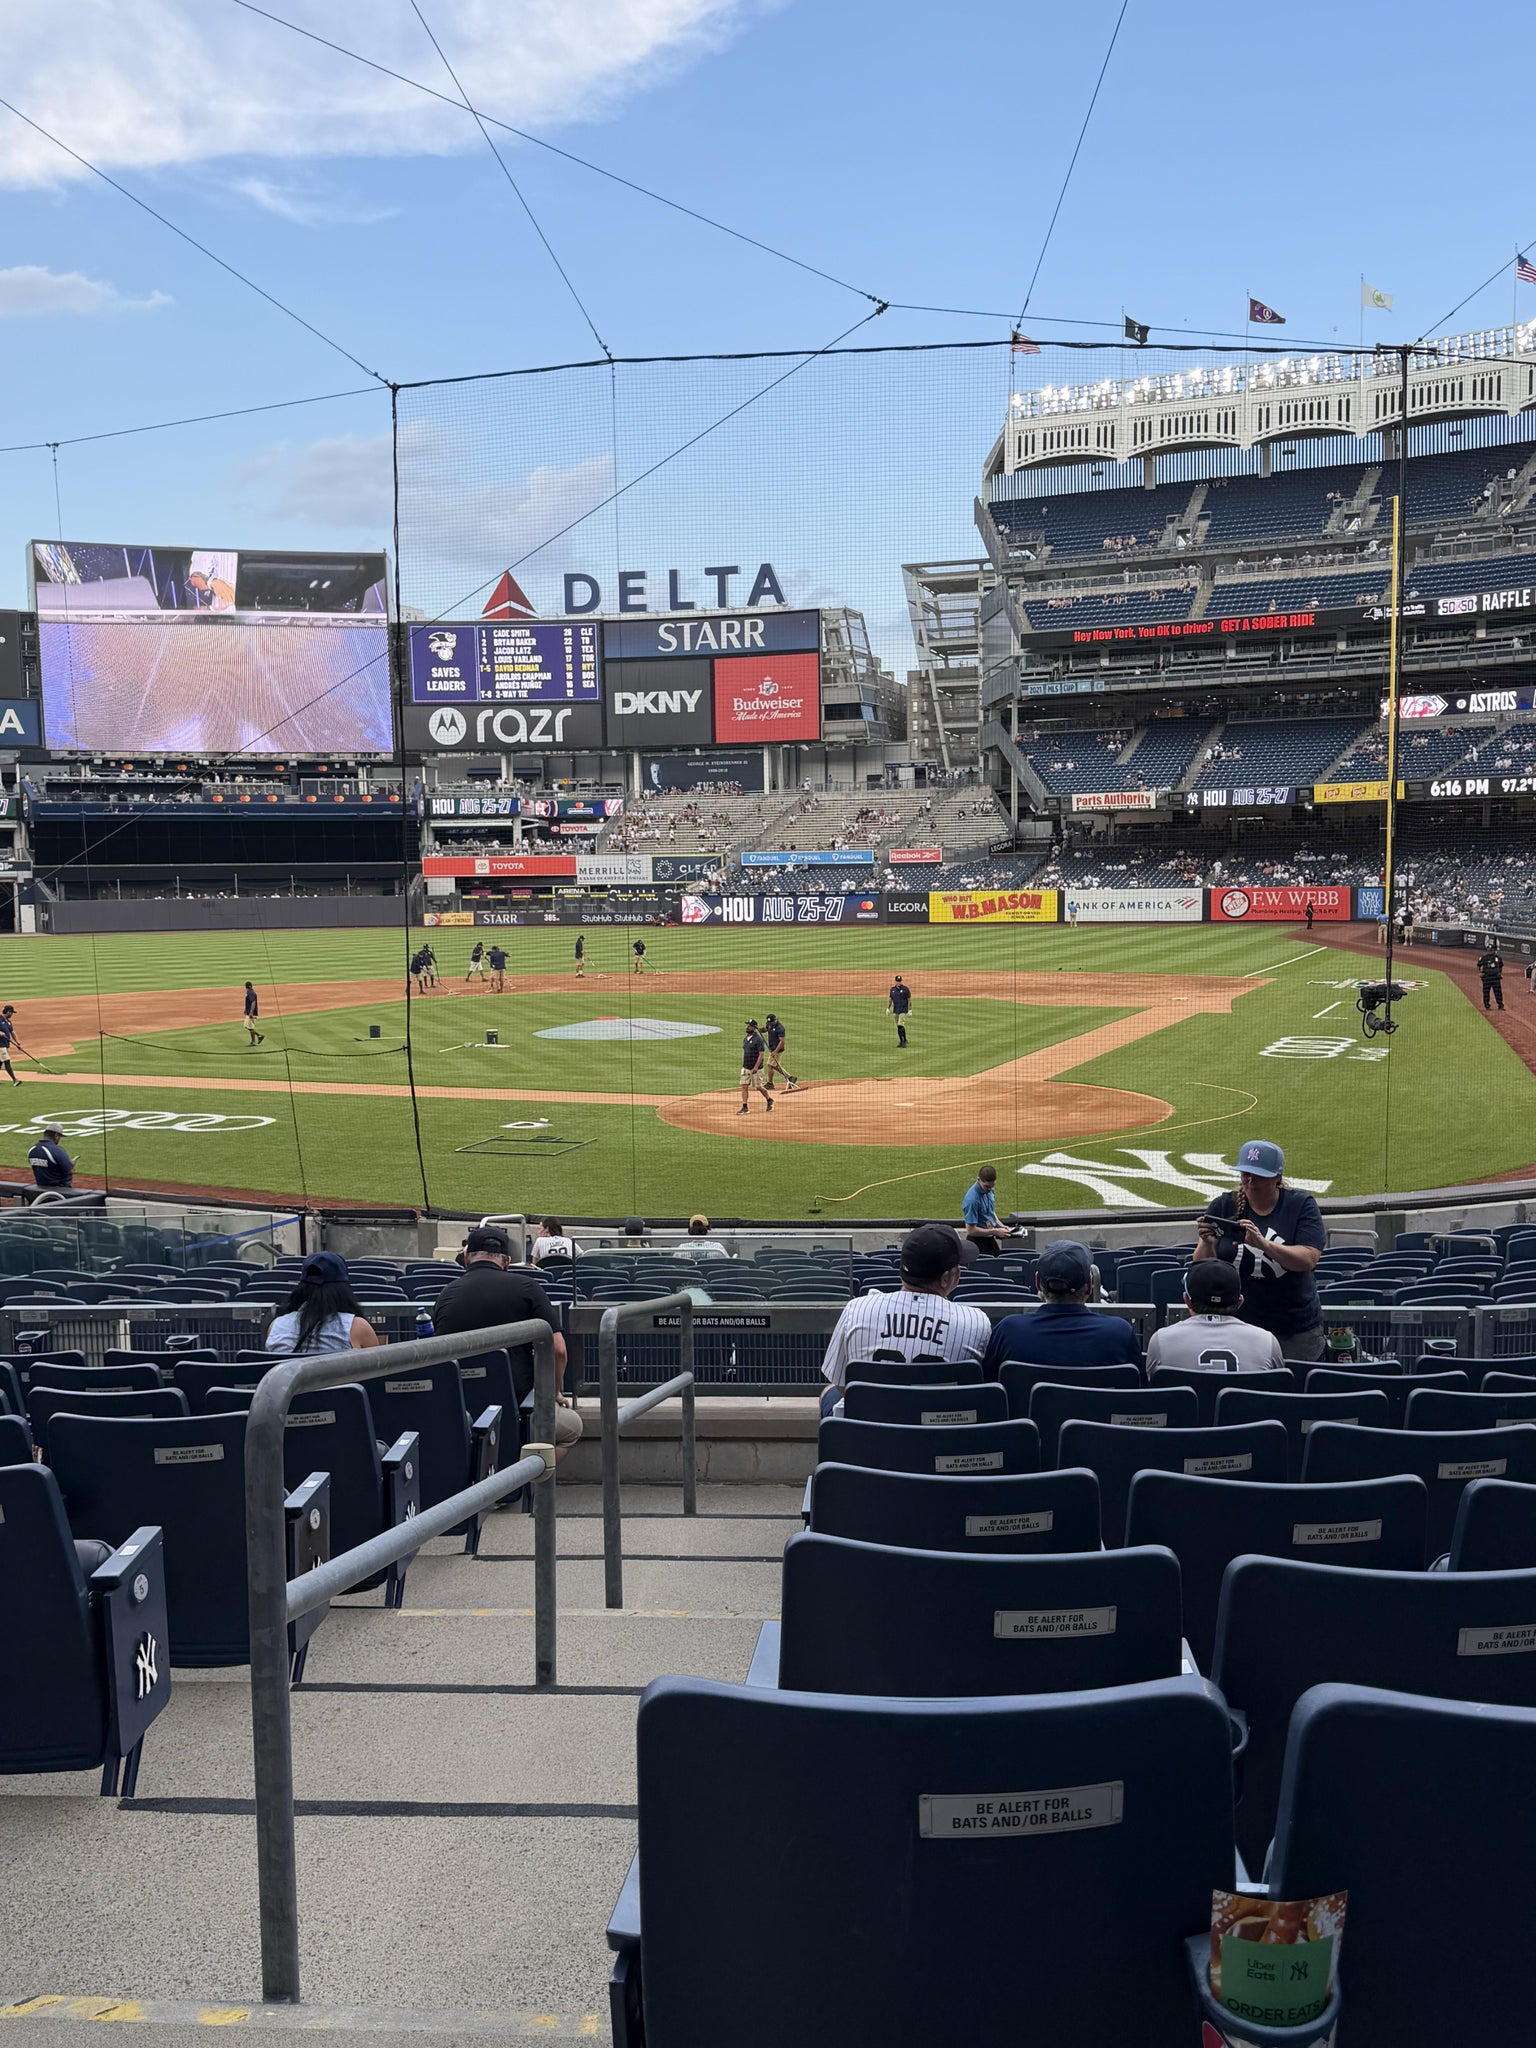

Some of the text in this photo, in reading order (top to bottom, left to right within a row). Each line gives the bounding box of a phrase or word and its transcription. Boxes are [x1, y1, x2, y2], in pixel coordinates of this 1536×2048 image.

[564, 563, 788, 614] DELTA
[1482, 589, 1531, 611] RAFFLE
[1221, 613, 1315, 633] GET A SOBER RIDE
[511, 629, 530, 638] SMITH
[580, 628, 593, 636] CLE
[658, 618, 767, 653] STARR
[1074, 621, 1214, 643] Hey New York, You OK to drive?
[493, 638, 515, 646] BRYAN
[516, 638, 537, 646] BAKER
[563, 637, 573, 645] 22
[494, 647, 515, 655] JACOB
[516, 647, 532, 655] LATZ
[581, 645, 594, 653] TEX
[494, 656, 512, 664] LOUIS
[513, 655, 543, 663] VARLAND
[565, 654, 573, 662] 17
[582, 654, 595, 662] TOR
[431, 667, 460, 678] SAVES
[494, 664, 514, 672] DAVID
[514, 664, 540, 672] BEDNAR
[582, 663, 595, 671] NYY
[523, 672, 551, 680] CHAPMAN
[582, 672, 595, 680] BOS
[426, 681, 466, 691] LEADERS
[582, 680, 595, 688] SEA
[1029, 686, 1043, 694] 2021
[1047, 685, 1059, 693] MLS
[1063, 684, 1075, 692] CUP
[495, 690, 516, 698] 2-WAY
[517, 690, 528, 698] TIE
[614, 690, 702, 715] DKNY
[733, 696, 803, 711] Budweiser
[1469, 690, 1517, 713] ASTROS
[732, 710, 801, 721] Made of America
[476, 708, 572, 743] razr
[1431, 779, 1489, 796] 6:16 PM
[1076, 793, 1151, 806] Parts Authority
[1204, 788, 1289, 806] HOU AUG 25-27
[432, 798, 511, 814] HOU AUG 25-27
[561, 825, 588, 833] TOYOTA
[891, 852, 921, 860] Reebok
[492, 862, 525, 870] TOYOTA
[579, 867, 625, 875] MERRILL
[942, 894, 973, 904] WHO BUT
[1252, 890, 1339, 906] F.W. WEBB
[1362, 892, 1378, 900] NEW
[1394, 890, 1406, 898] 314
[722, 896, 845, 922] HOU AUG 25-27
[888, 902, 928, 913] LEGORA
[1119, 901, 1172, 909] AMERICA
[1360, 900, 1381, 908] YORK
[1362, 907, 1379, 915] LIFE
[483, 914, 518, 924] STARR
[582, 914, 643, 922] StubHub StubHub
[720, 1318, 745, 1326] AND/OR
[881, 1313, 949, 1345] JUDGE
[1028, 1614, 1084, 1624] BE ALERT FOR
[1013, 1622, 1098, 1633] BATS AND/OR BALLS
[1493, 1630, 1532, 1640] BE ALERT
[1477, 1638, 1535, 1649] BATS AND/OR
[976, 1798, 1070, 1815] BE ALERT FOR
[952, 1808, 1093, 1829] BATS AND/OR BALLS
[1247, 1958, 1276, 1972] Uber
[1246, 1969, 1275, 1981] Eats
[1227, 1997, 1321, 2021] ORDER EATS
